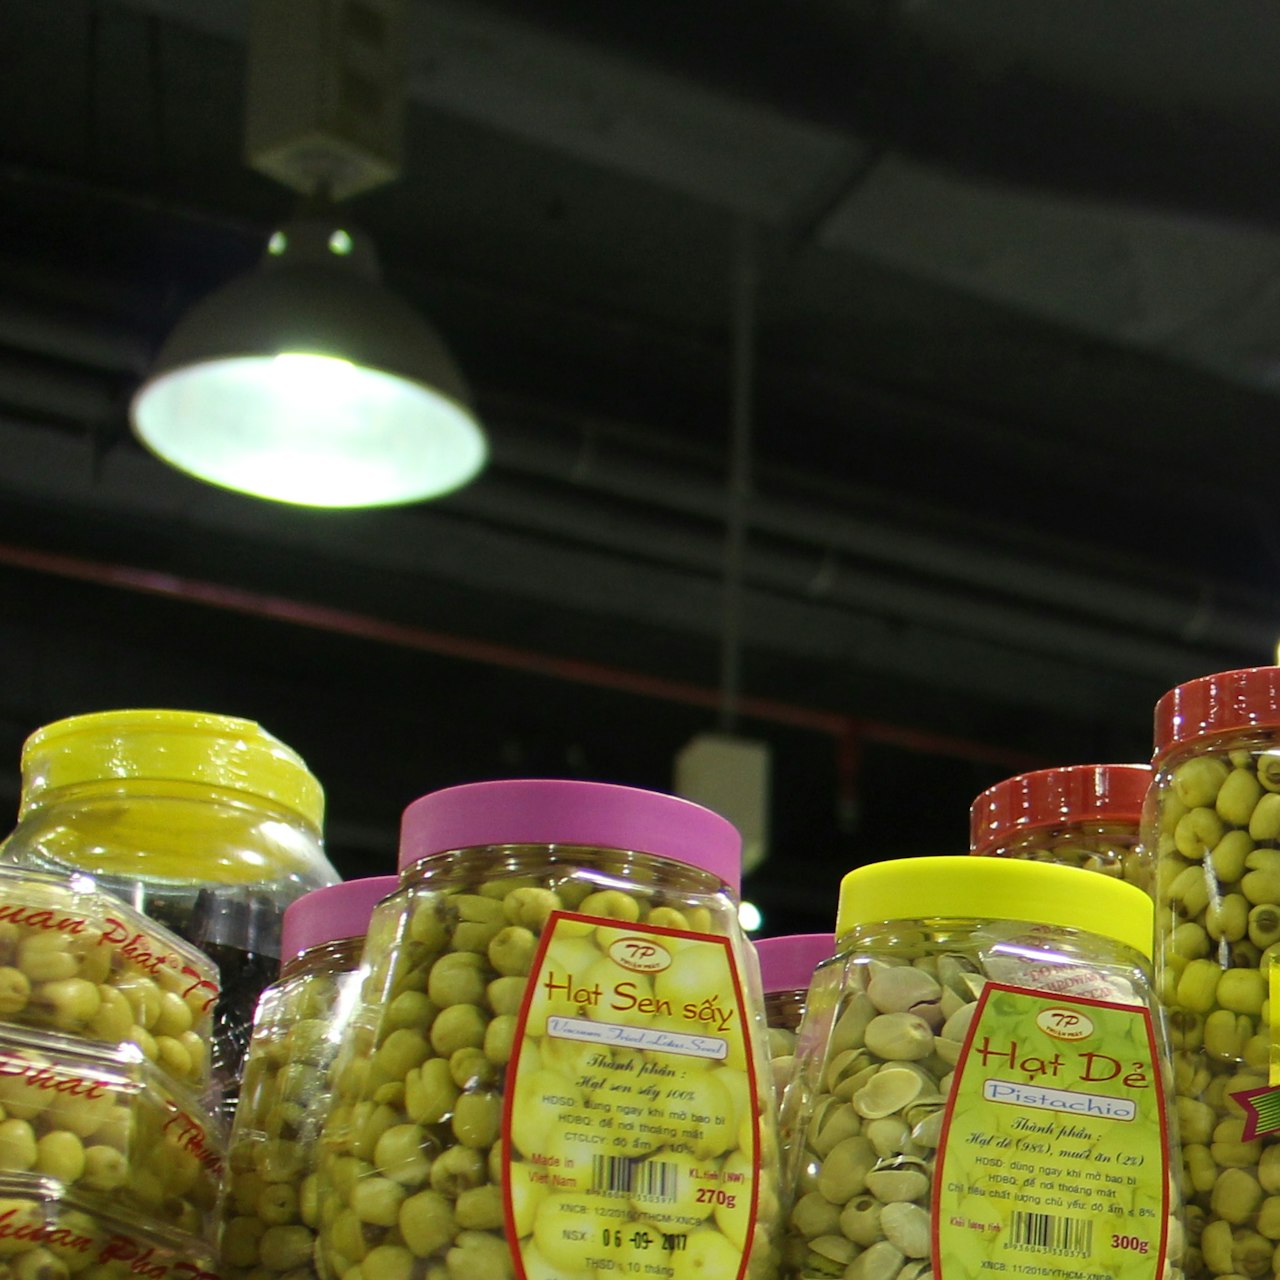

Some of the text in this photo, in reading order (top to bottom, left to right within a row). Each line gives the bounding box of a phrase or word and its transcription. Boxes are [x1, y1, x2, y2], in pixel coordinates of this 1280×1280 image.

[610, 982, 672, 1016] Sen
[683, 995, 733, 1032] sấy
[975, 1037, 1150, 1088] Hạt Dẻ
[989, 1084, 1130, 1117] Pistachio
[696, 1188, 736, 1209] 270g
[1111, 1235, 1149, 1254] 300g
